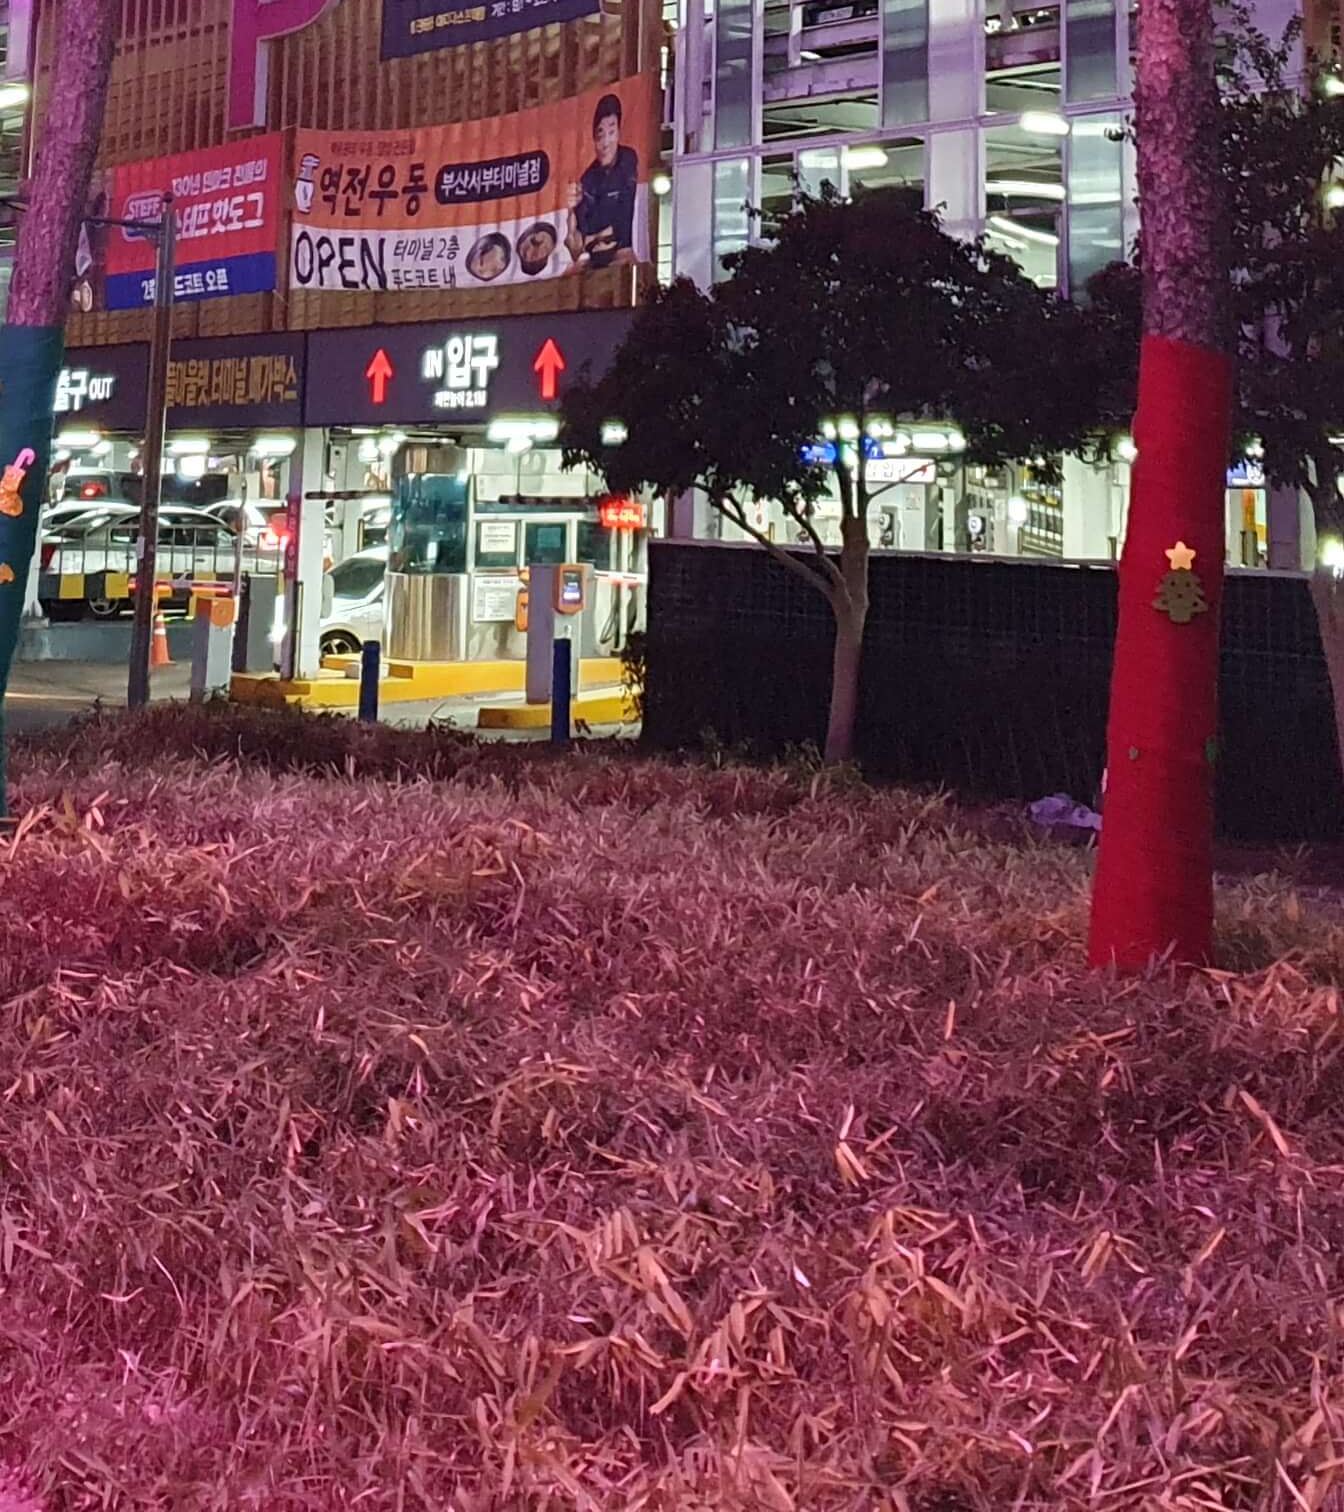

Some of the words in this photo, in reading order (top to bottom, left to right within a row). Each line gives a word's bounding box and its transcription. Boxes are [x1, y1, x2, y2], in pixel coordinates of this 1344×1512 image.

[320, 162, 429, 216] 역전우동
[440, 156, 542, 197] 부산서부터미널점
[211, 191, 264, 234] 핫도그
[294, 230, 388, 291] OPEN
[393, 238, 433, 262] 터미널
[436, 235, 460, 260] 2층
[173, 272, 205, 296] 드코트
[205, 267, 229, 290] 오픈
[391, 268, 440, 289] 푸드코트
[443, 266, 456, 289] 내
[211, 357, 249, 405] 터미널
[249, 355, 298, 404] 메가박스
[422, 349, 444, 379] IN
[447, 334, 499, 388] 입구
[89, 376, 114, 401] OUT
